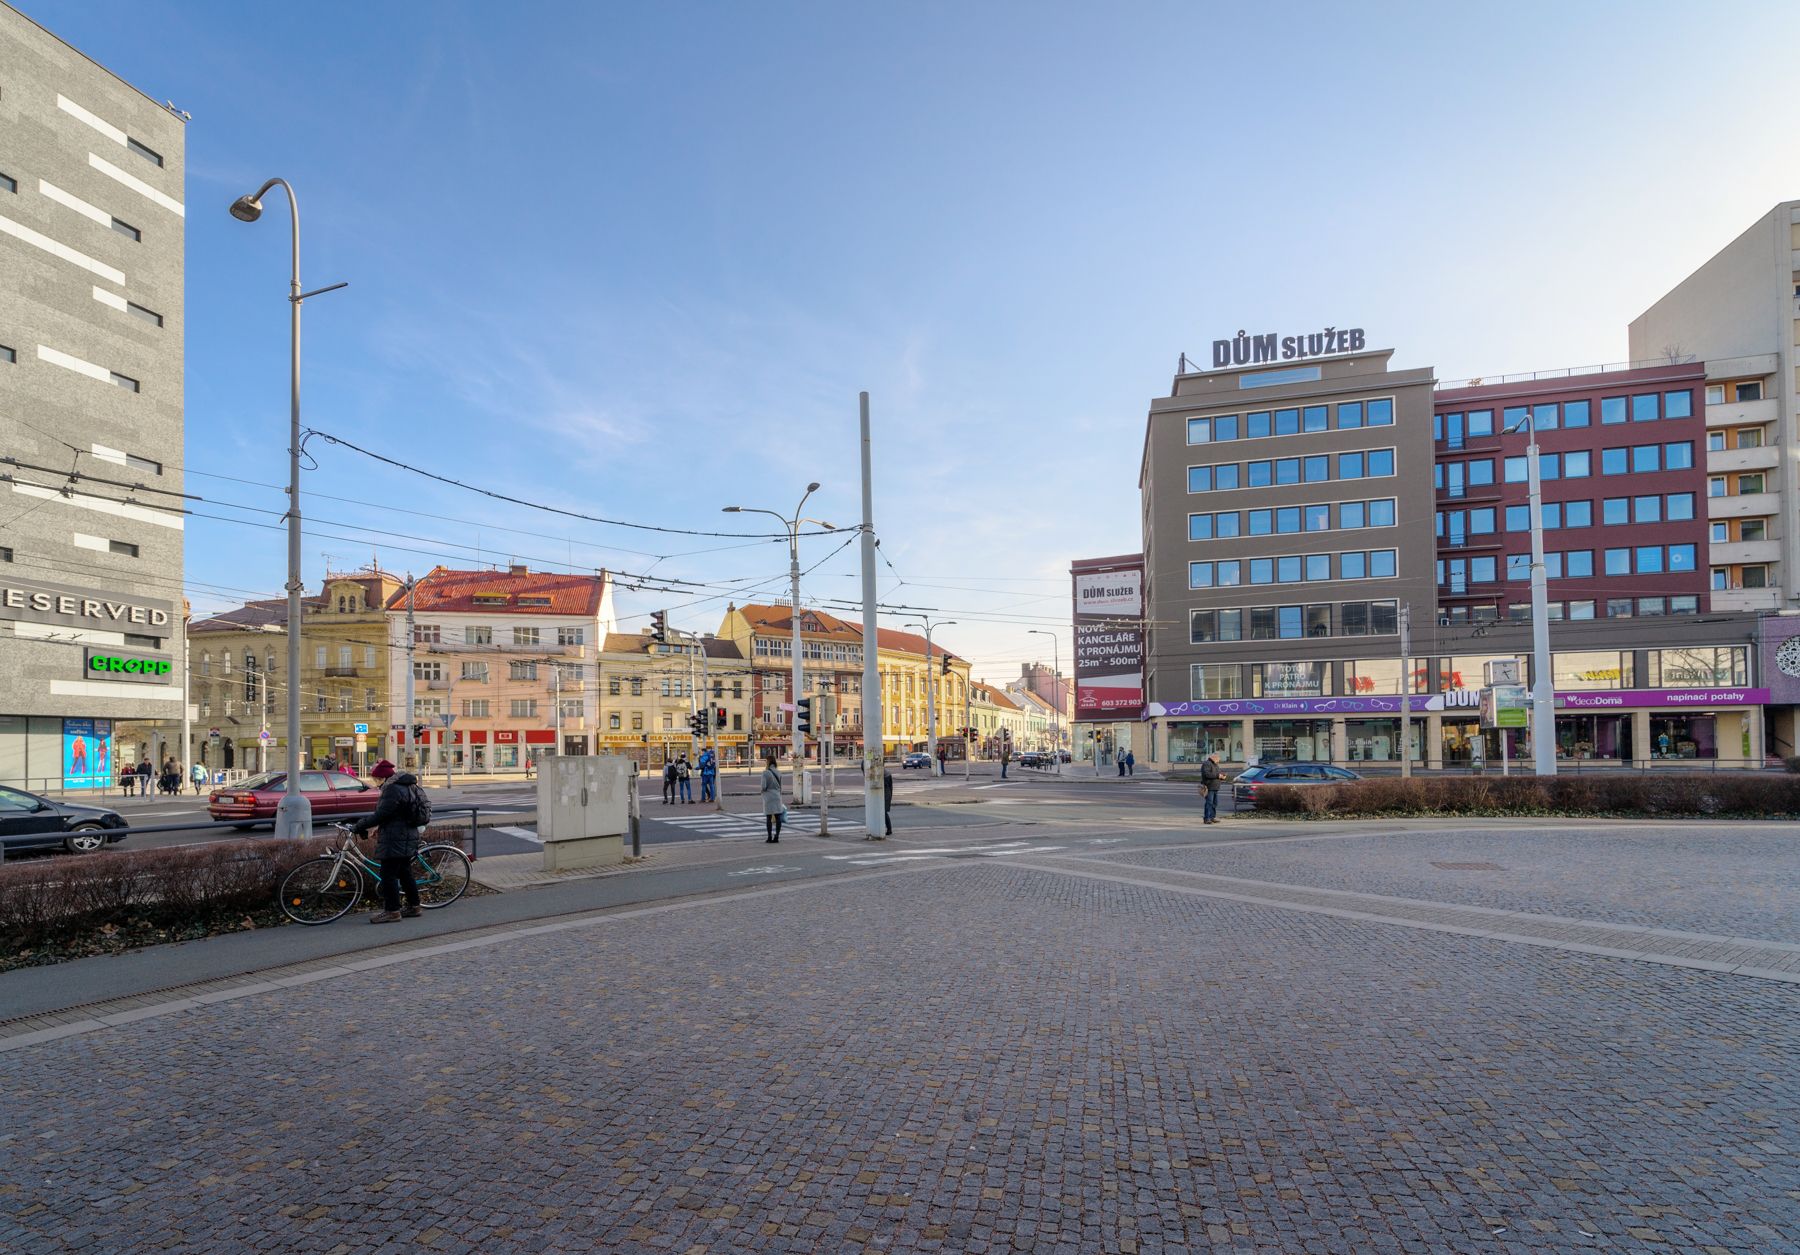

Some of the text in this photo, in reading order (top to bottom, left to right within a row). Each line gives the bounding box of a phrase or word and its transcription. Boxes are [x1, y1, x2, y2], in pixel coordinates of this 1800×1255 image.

[1213, 326, 1366, 369] DŮM SLUŽEB
[1083, 585, 1134, 599] DŮM SLUŽEB
[4, 588, 169, 626] ESERVED
[1078, 633, 1135, 645] KANCELÁŘE
[1078, 644, 1141, 656] K PRONÁJMU
[90, 655, 171, 676] CROPP
[1280, 665, 1303, 673] TOTO
[1272, 680, 1319, 688] PRONÁJMU
[1575, 696, 1623, 705] decoDoma
[1666, 692, 1745, 703] napínací potahy
